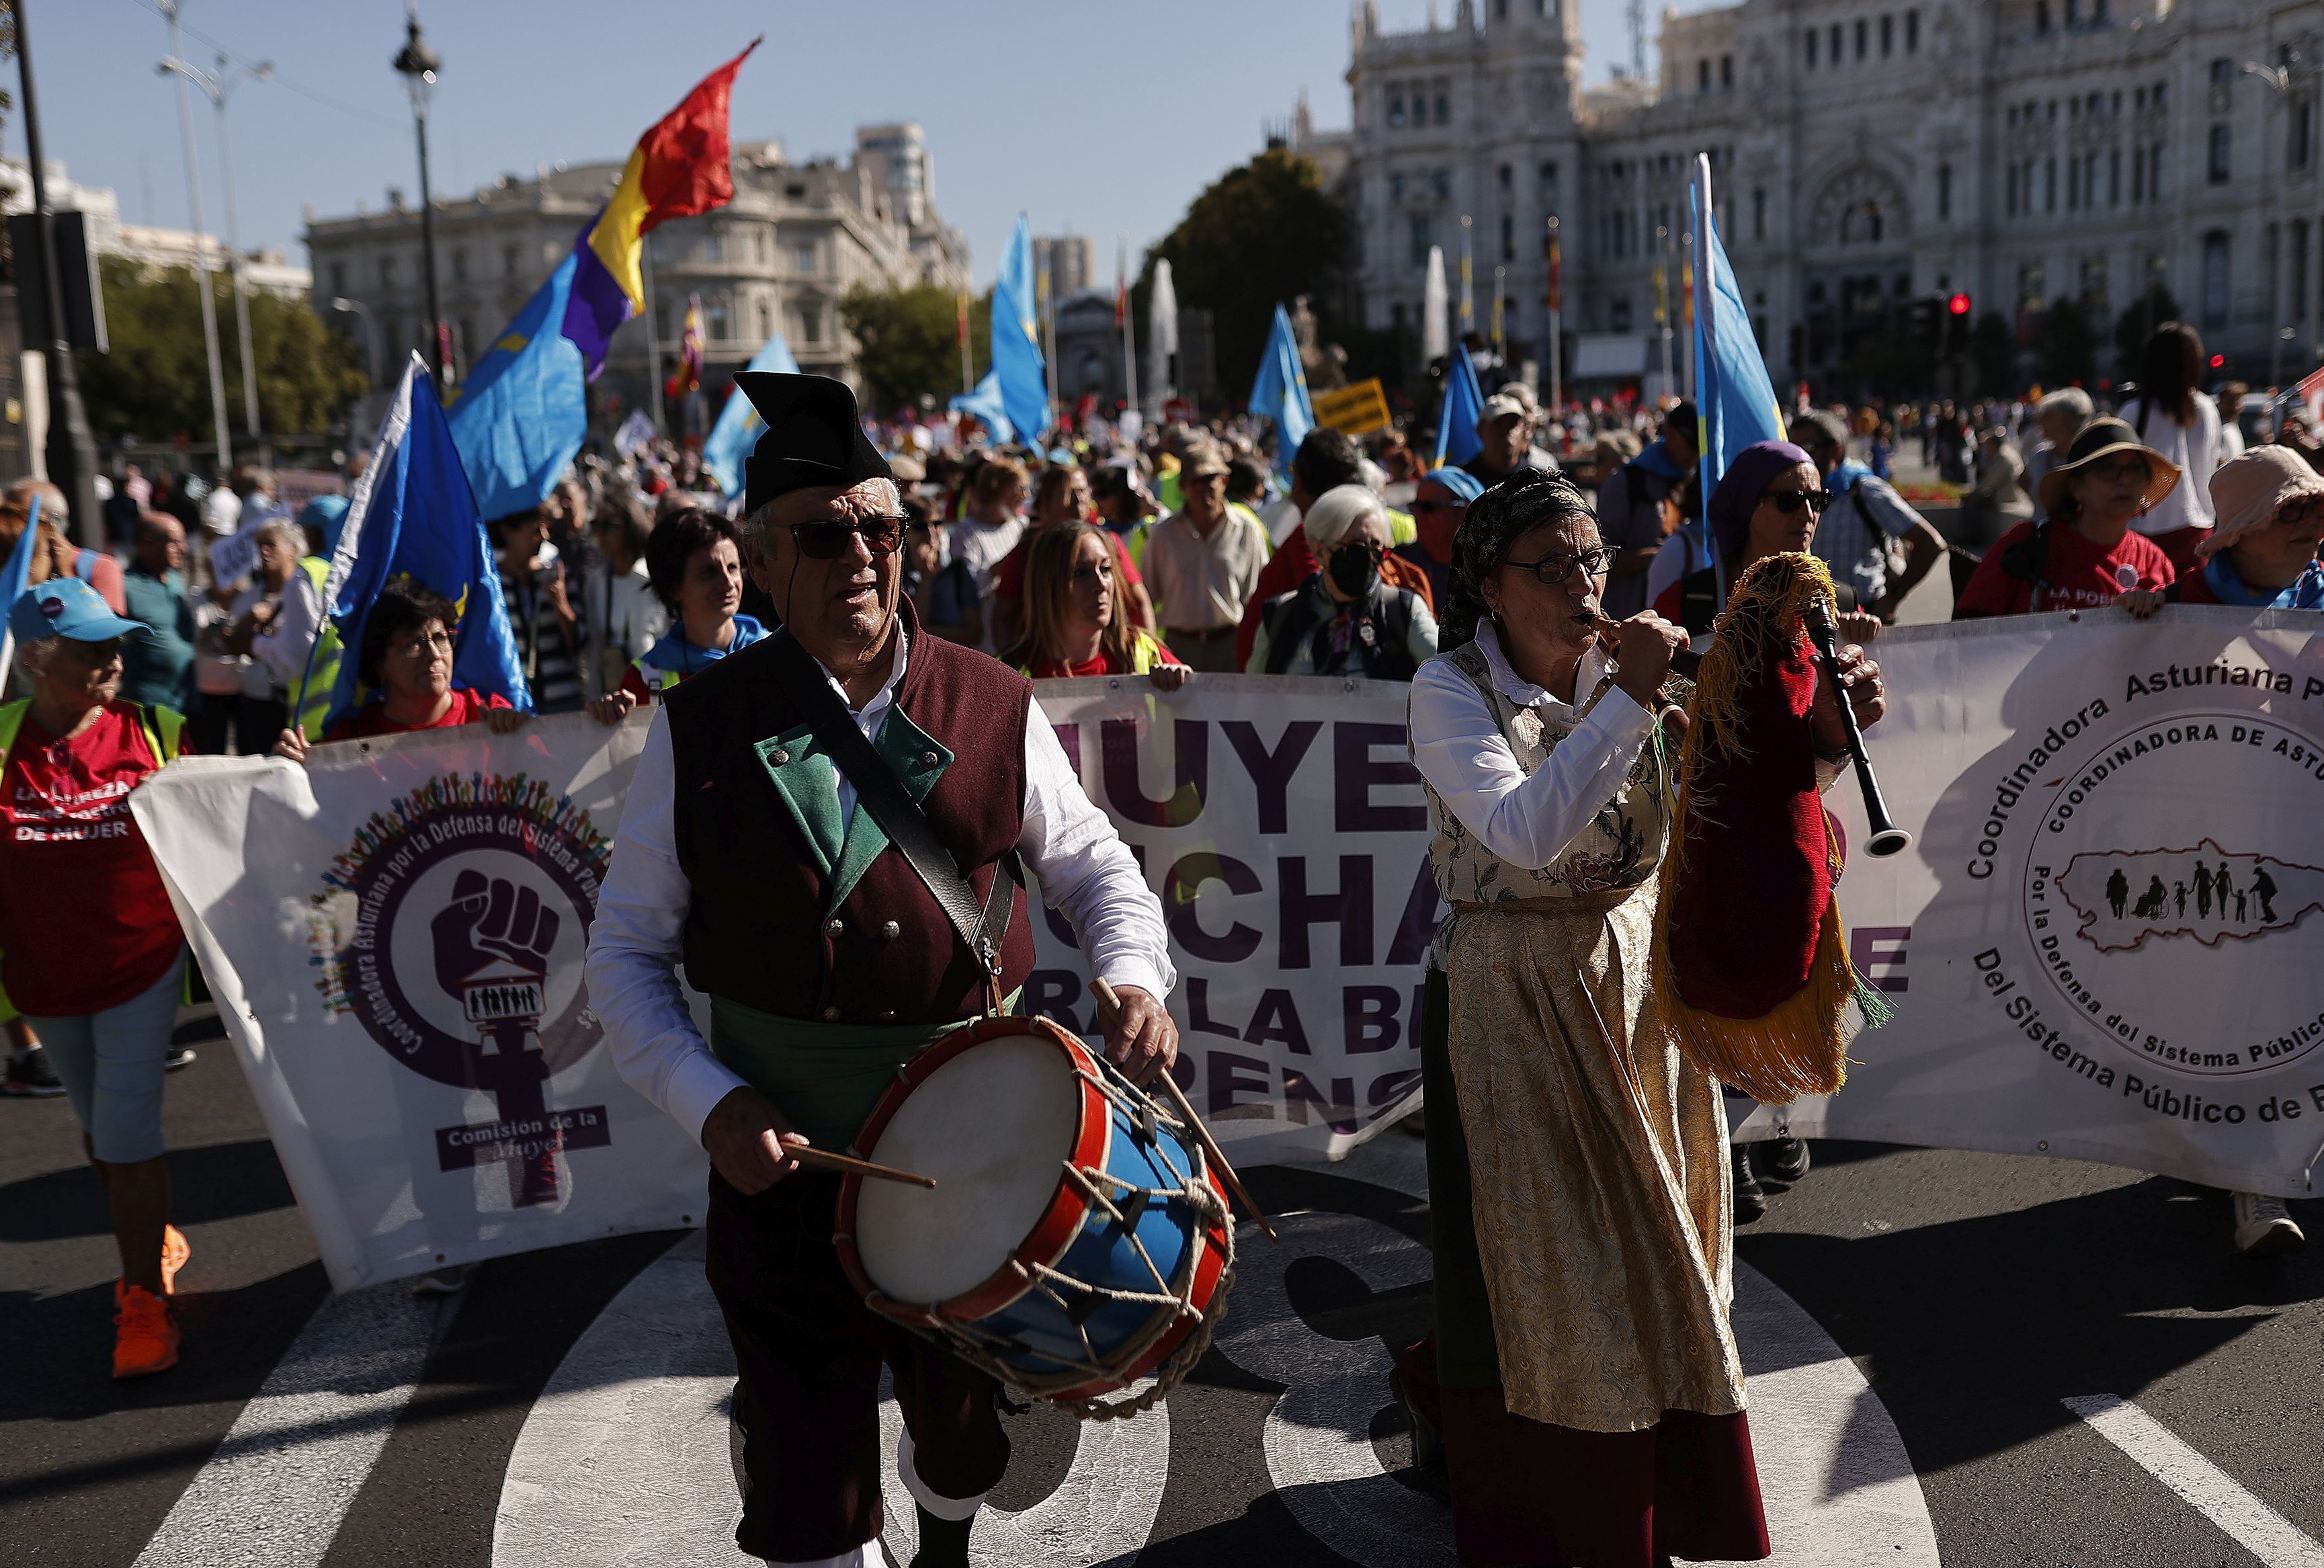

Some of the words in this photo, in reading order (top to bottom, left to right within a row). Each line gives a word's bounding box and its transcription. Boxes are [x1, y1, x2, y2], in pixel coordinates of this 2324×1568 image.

[2049, 585, 2070, 600] LA
[2075, 588, 2114, 606] POB
[1052, 720, 1429, 835] UYE
[1966, 697, 2110, 880] Coordinadora
[2125, 658, 2293, 702] Asturiana
[2302, 675, 2324, 710] P
[2049, 723, 2219, 834] COORDINADORA
[2231, 725, 2266, 747] DE
[15, 826, 48, 841] DE
[51, 820, 130, 841] MUJER
[409, 833, 431, 854] la
[428, 814, 493, 845] Defensa
[498, 815, 522, 838] del
[386, 844, 415, 878] por
[526, 822, 580, 874] Sistema
[2032, 864, 2051, 901] Por
[352, 872, 395, 950] Asturiana
[2032, 908, 2050, 930] la
[2040, 934, 2102, 1015] Defensa
[358, 954, 423, 1055] Coordinadora
[1186, 977, 1312, 1056] LA
[1973, 946, 2016, 998] Del
[2005, 995, 2117, 1089] Sistema
[2122, 1073, 2247, 1124] Público
[2258, 1095, 2302, 1123] de
[2105, 1014, 2140, 1042] del
[2143, 1034, 2240, 1067] Sistema
[549, 1115, 573, 1130] de
[579, 1112, 598, 1127] la
